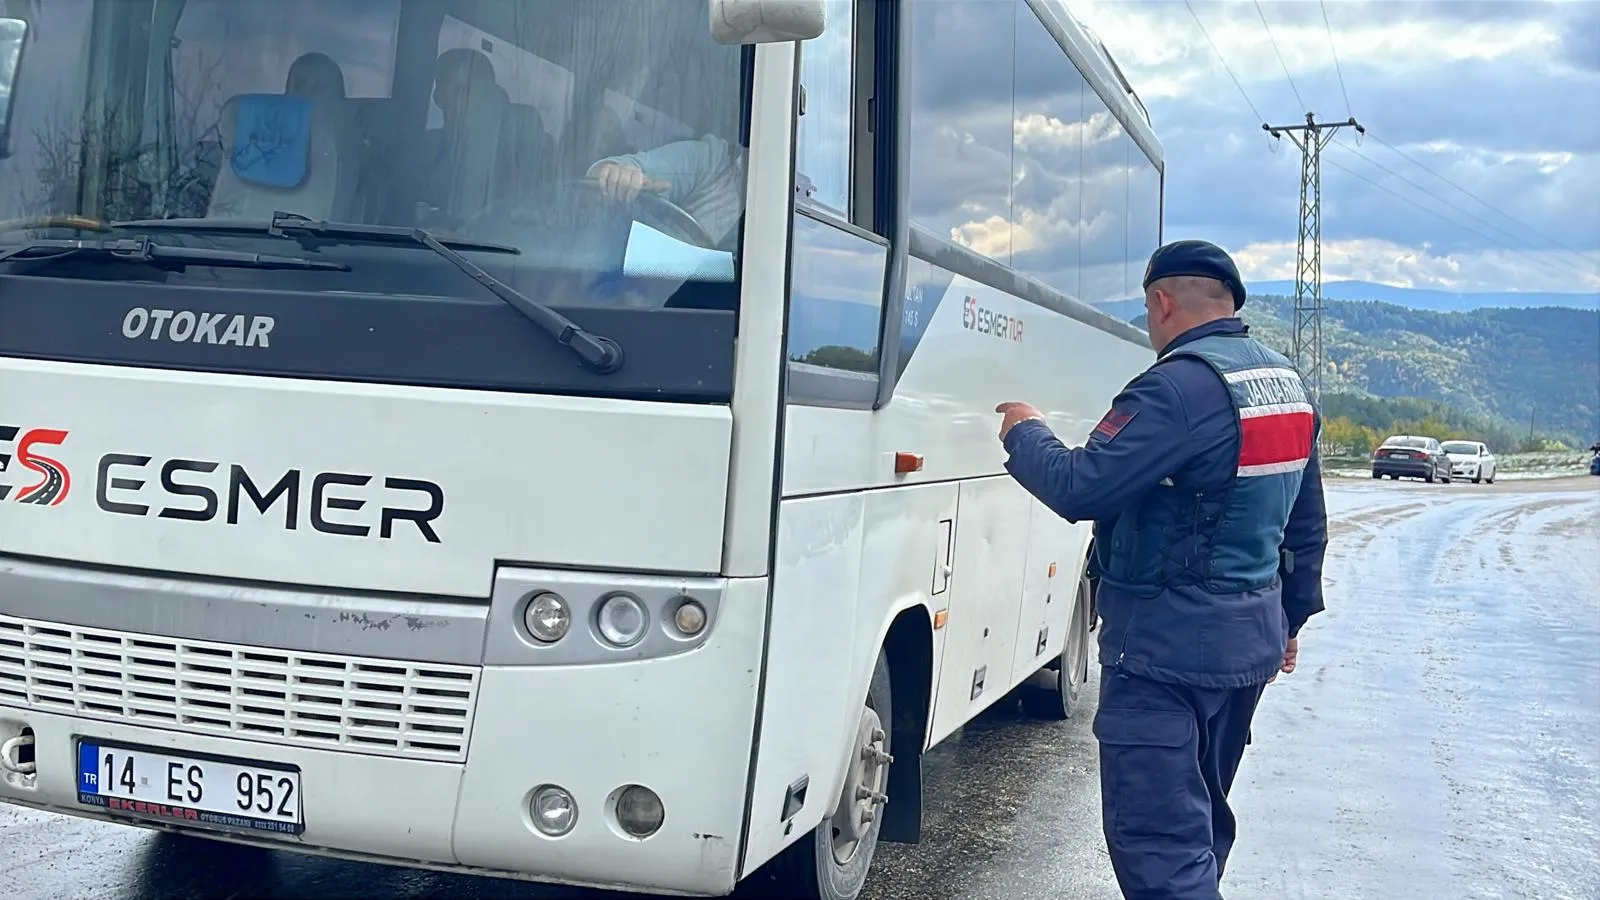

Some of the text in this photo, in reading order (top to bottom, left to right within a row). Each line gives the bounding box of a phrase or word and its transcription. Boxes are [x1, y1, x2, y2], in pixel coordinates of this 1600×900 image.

[122, 307, 275, 347] OTOKAR
[97, 453, 444, 543] ESMER
[81, 794, 104, 805] KONYA
[109, 798, 198, 820] EKERLER
[84, 753, 293, 817] TR 14 ES 952
